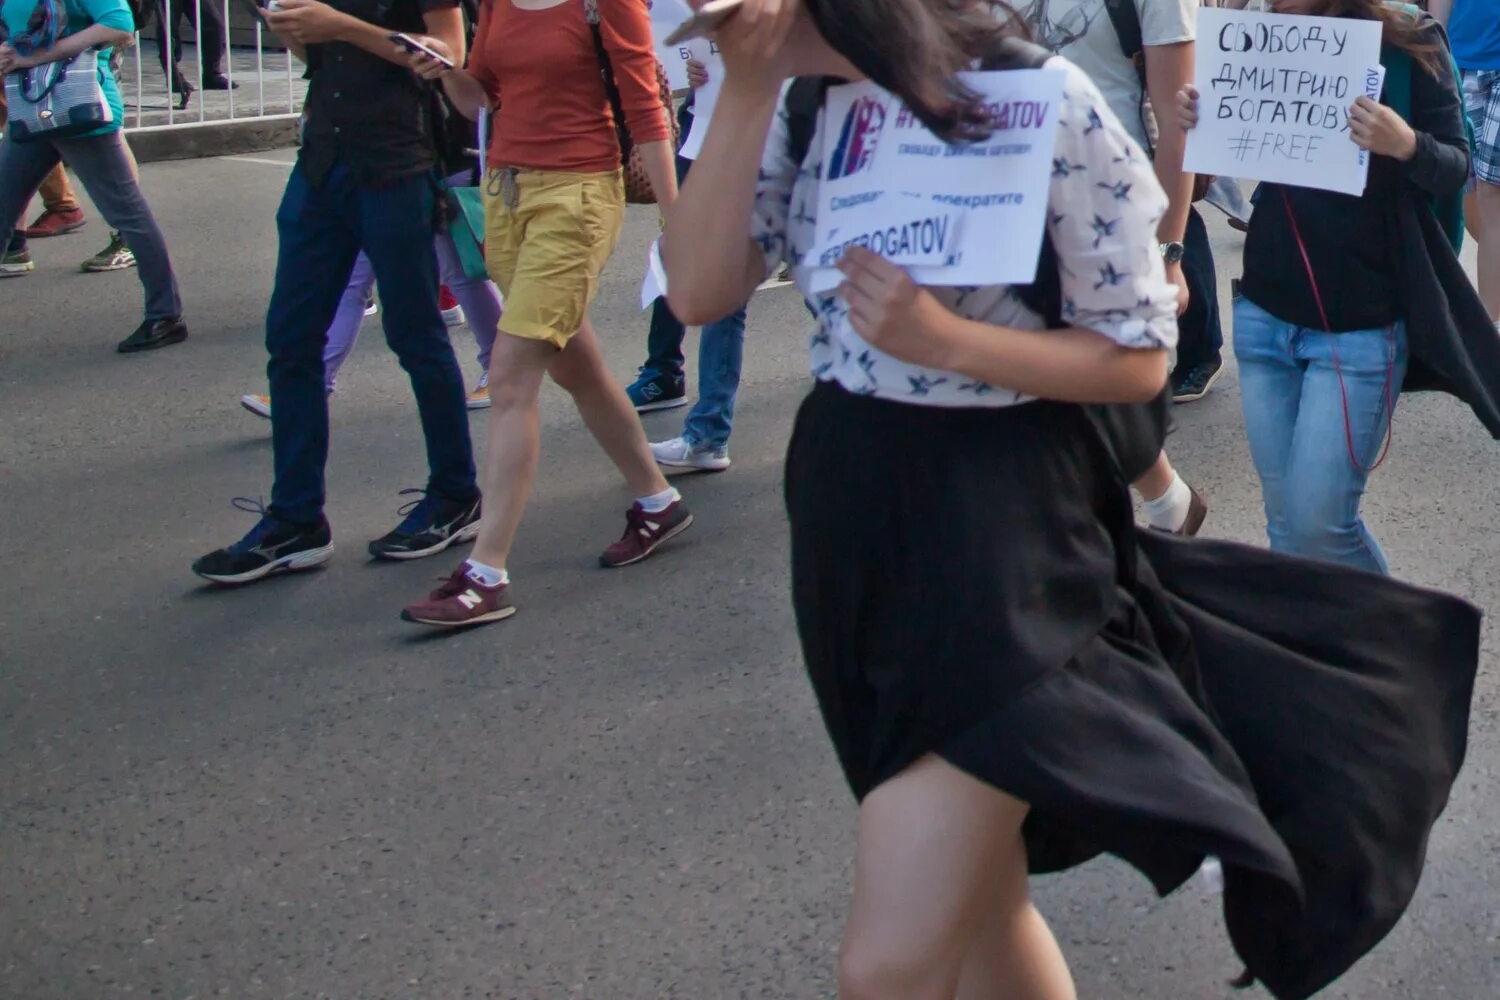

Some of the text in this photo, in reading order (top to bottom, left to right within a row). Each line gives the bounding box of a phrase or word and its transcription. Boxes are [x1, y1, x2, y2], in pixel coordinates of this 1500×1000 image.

[1218, 22, 1348, 56] СВОБОДУ
[1211, 63, 1348, 99] ДМИТРИЮ
[1227, 129, 1324, 163] #FREE
